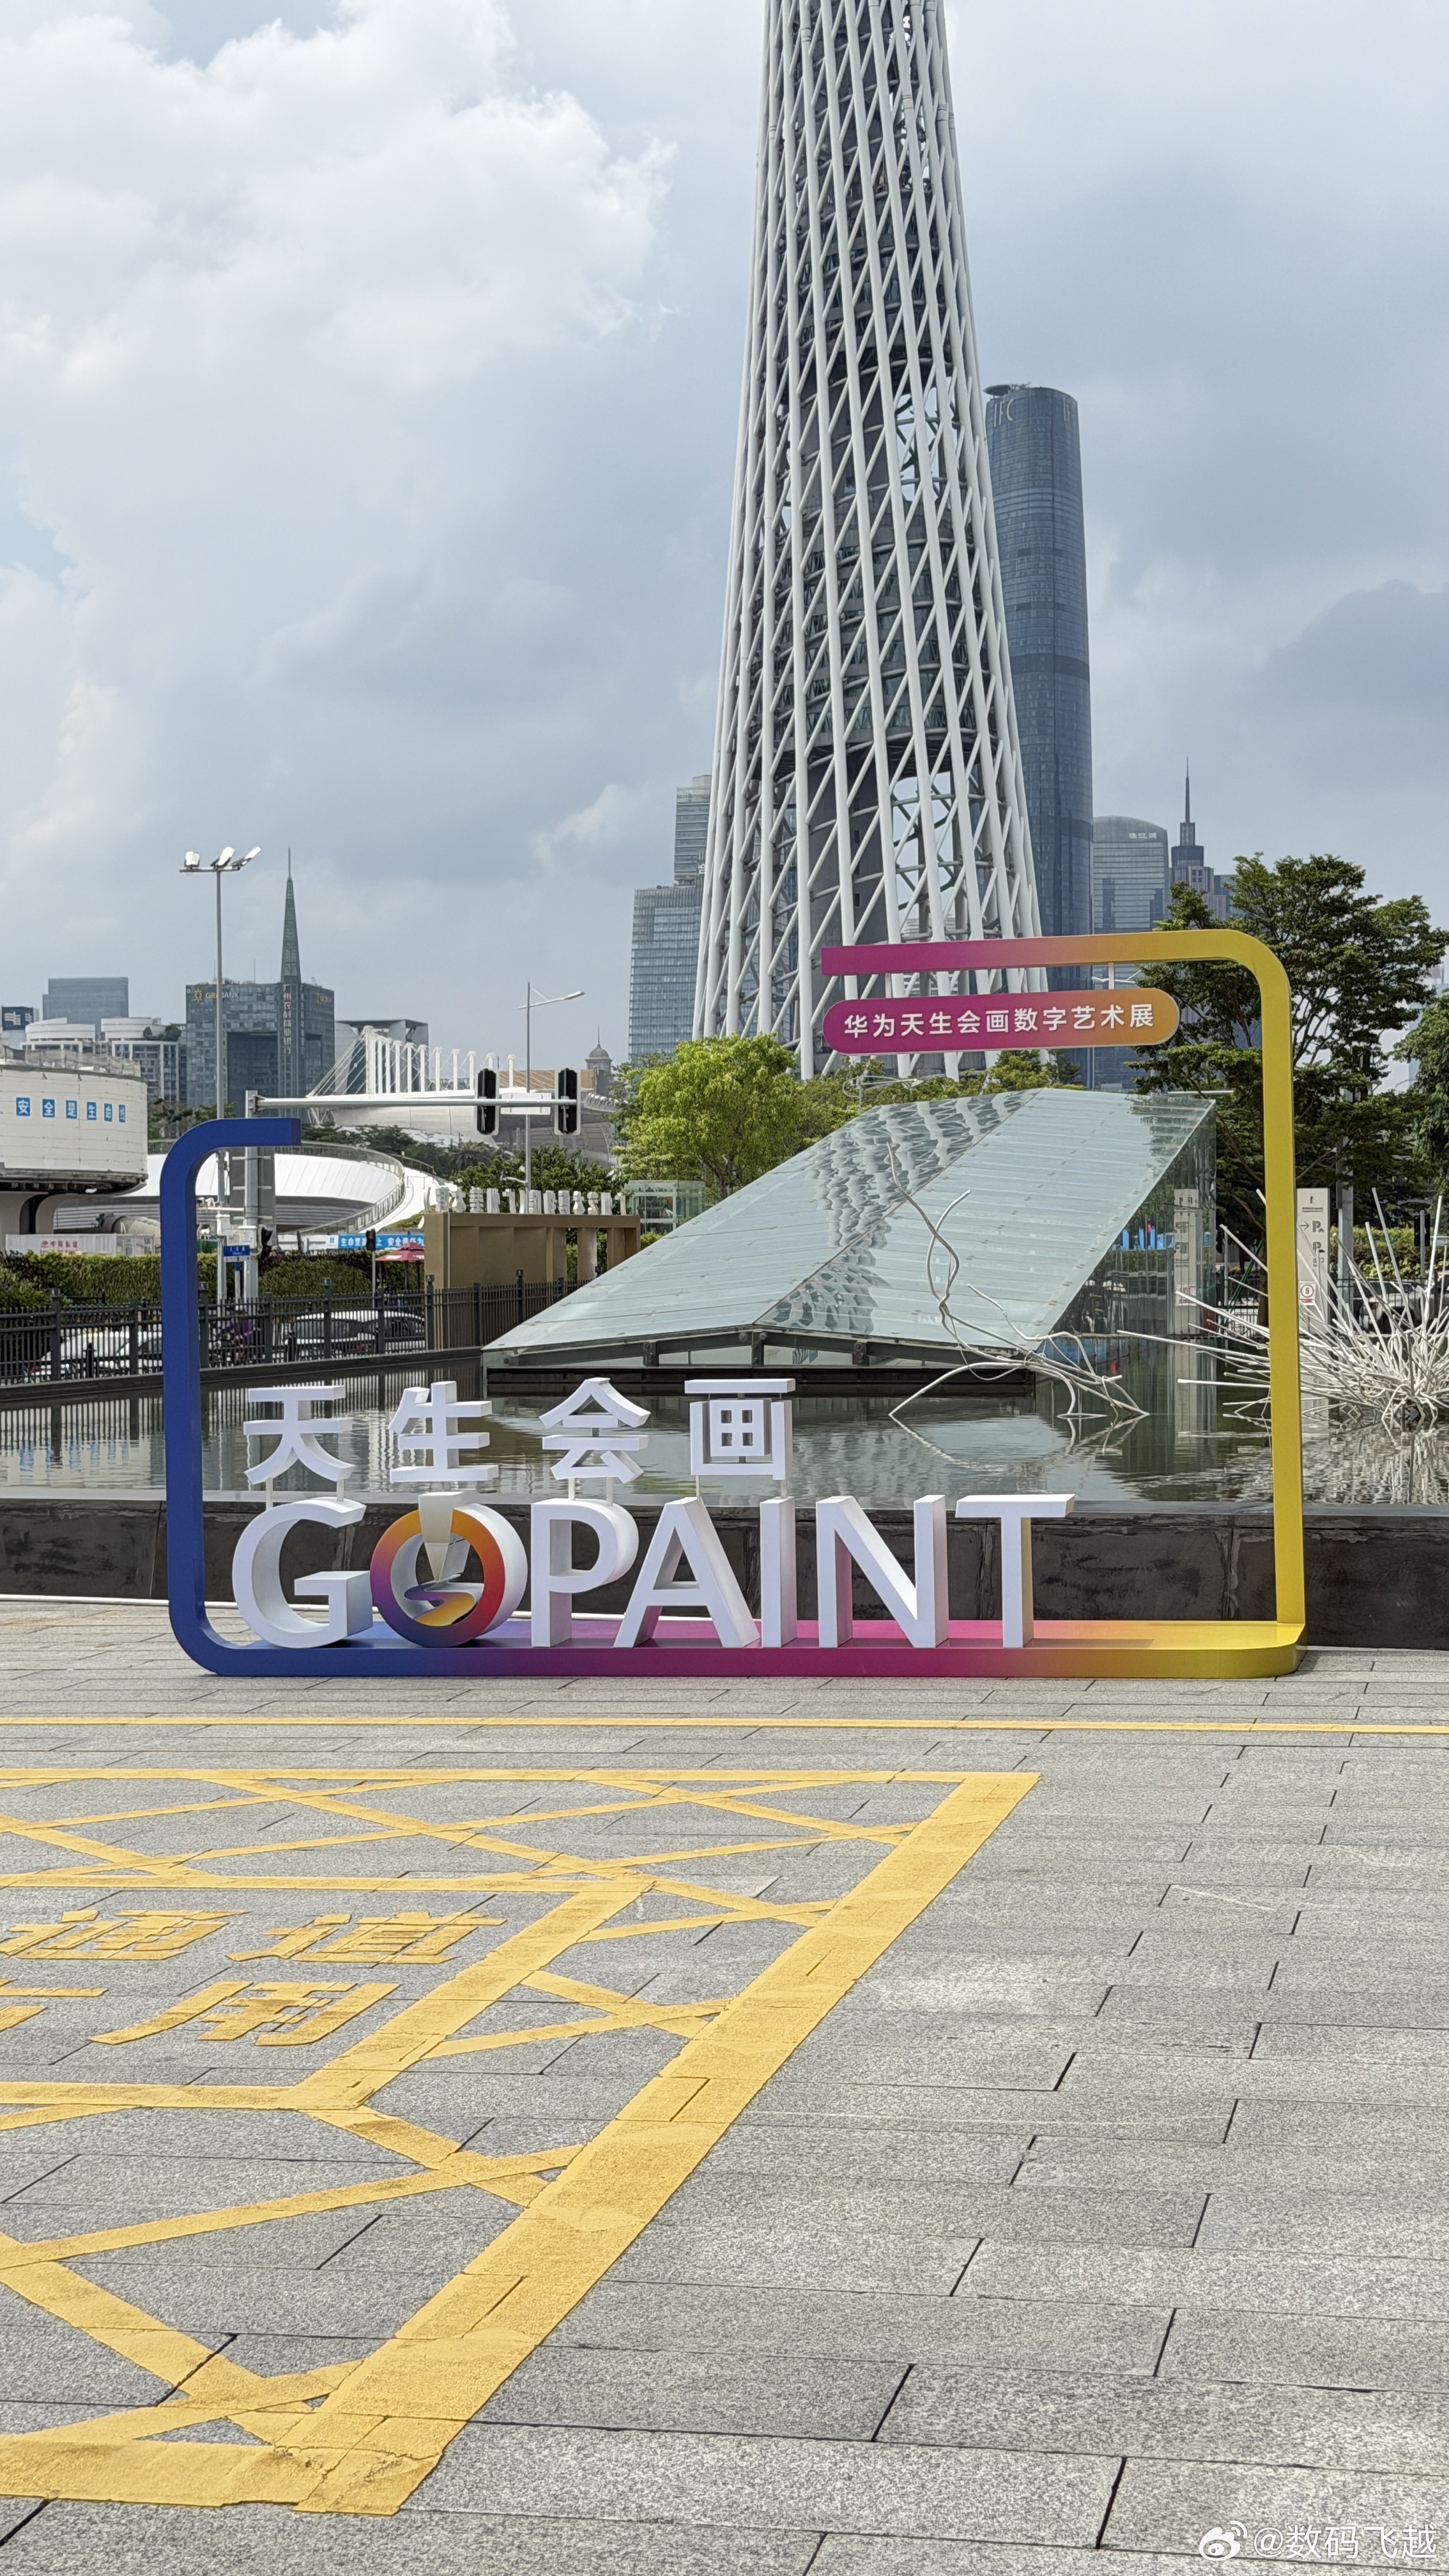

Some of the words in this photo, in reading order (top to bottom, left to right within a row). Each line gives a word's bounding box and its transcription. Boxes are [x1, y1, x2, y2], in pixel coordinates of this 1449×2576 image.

[993, 397, 1013, 427] IFC
[283, 984, 291, 1054] 广州农村商业银行
[844, 1003, 1154, 1039] 华为天生会画数字艺术展
[243, 1377, 795, 1485] 天生会画
[232, 1492, 1076, 1649] GOPAINT
